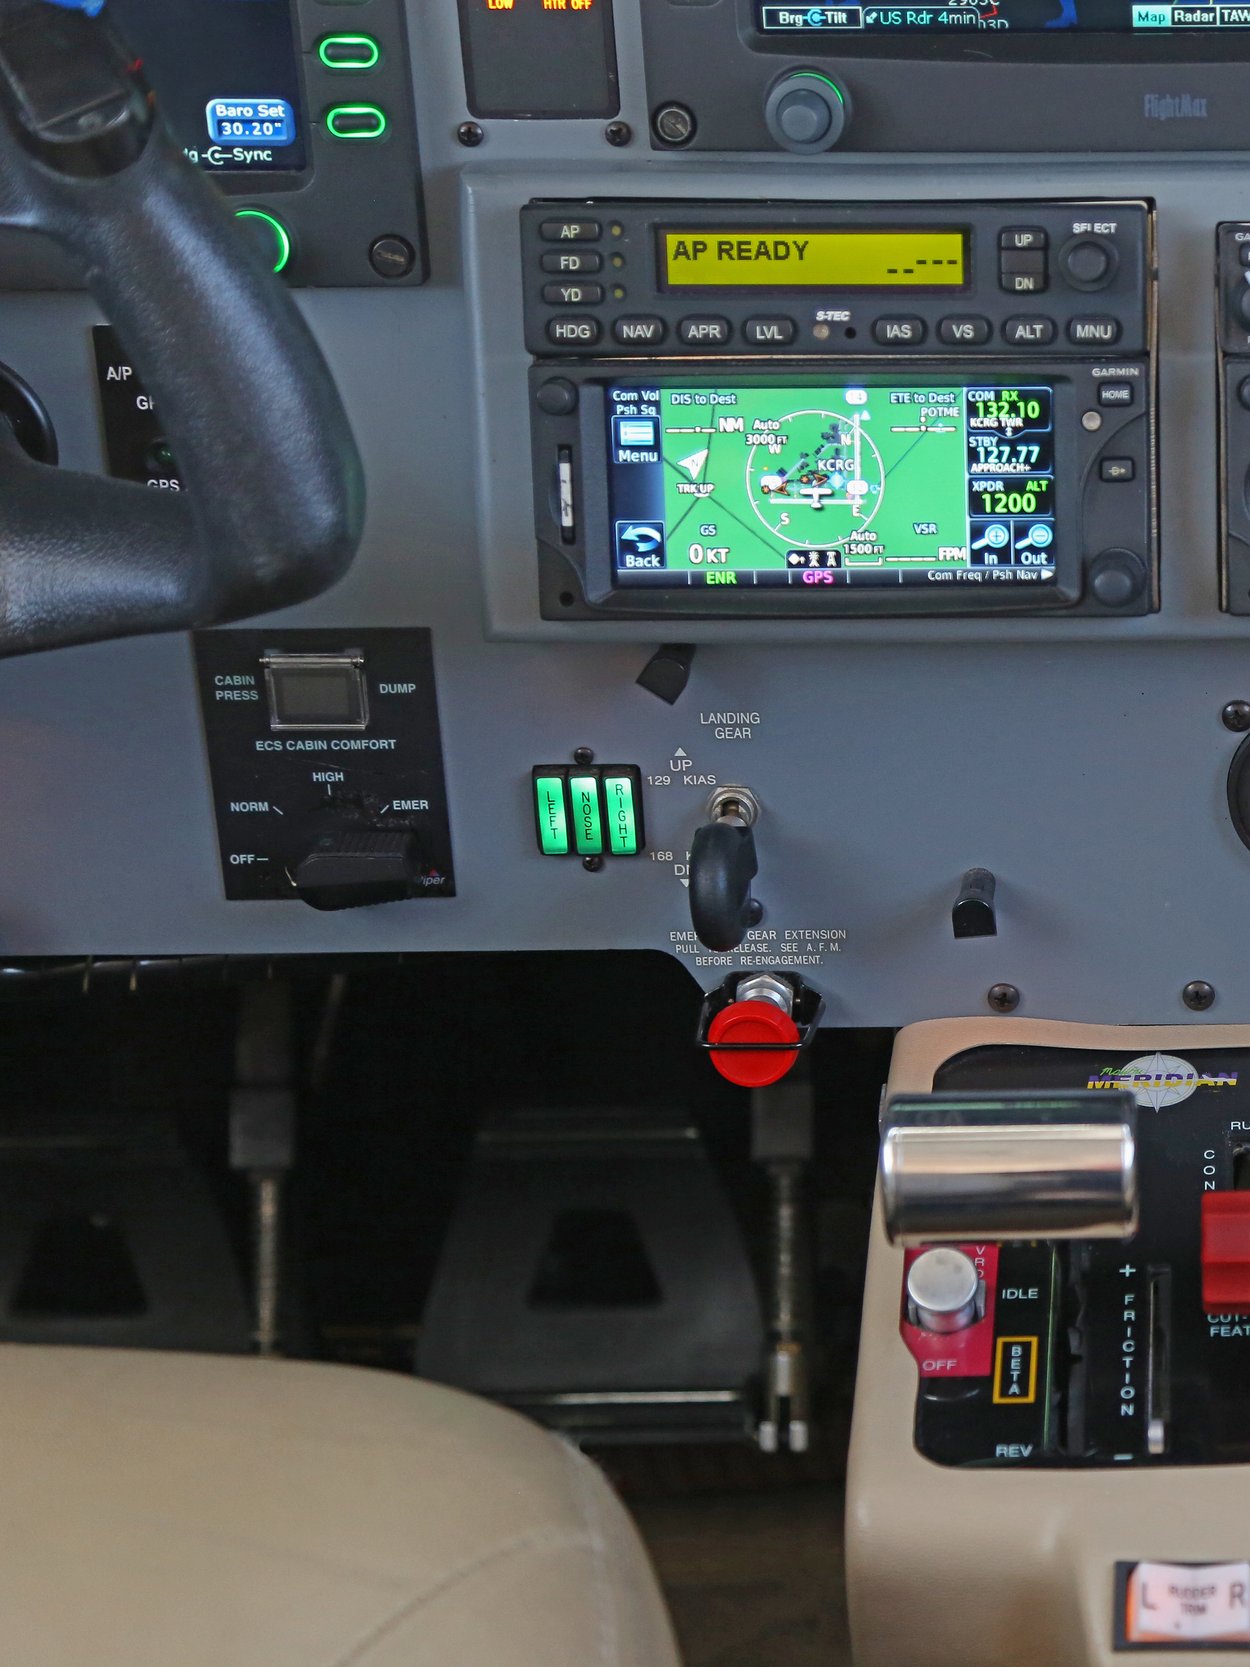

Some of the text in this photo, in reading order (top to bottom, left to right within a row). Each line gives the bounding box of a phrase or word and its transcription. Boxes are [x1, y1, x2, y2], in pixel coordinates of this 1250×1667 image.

[779, 11, 847, 26] Brg Tilt
[880, 11, 902, 25] US
[906, 10, 933, 25] Rdr
[938, 11, 976, 25] 4min
[1138, 12, 1165, 24] Map
[1174, 11, 1215, 23] Radar
[216, 104, 285, 117] Baro Set
[233, 147, 272, 163] Sync
[560, 226, 580, 239] AP
[1015, 234, 1033, 246] UP
[672, 240, 809, 261] AP READY
[560, 256, 580, 270] FD
[1015, 278, 1034, 290] DN
[561, 288, 581, 301] YD
[816, 310, 850, 321] S-TEC
[556, 324, 783, 339] HDG NAV APR LVL
[886, 325, 1112, 338] IAS VS ALT MNU
[107, 366, 132, 380] A/P
[1092, 368, 1139, 377] GARMIN
[613, 390, 659, 401] Com Vol
[671, 394, 737, 405] DIS to Dest
[968, 390, 1019, 401] COM RX
[976, 401, 1040, 419] 132.10
[618, 450, 658, 462] Menu
[976, 446, 1040, 463] 127.77
[972, 480, 1049, 491] XPDR ALT
[982, 493, 1037, 513] 1200
[625, 554, 661, 568] Back
[1021, 551, 1048, 565] Out
[706, 571, 737, 584] ENR
[802, 571, 834, 584] GPS
[215, 676, 255, 686] CABIN
[379, 684, 416, 694] DUMP
[216, 691, 259, 701] PRESS
[700, 712, 760, 724] LANDING
[714, 727, 752, 739] GEAR
[256, 740, 397, 751] ECS CABIN COMFORT
[669, 759, 693, 772] UP
[313, 772, 344, 782] HIGH
[647, 774, 716, 786] 129 KIAS
[231, 802, 268, 812] NORM
[393, 800, 429, 811] EMER
[546, 790, 558, 840] LEFT
[581, 791, 593, 840] NOSE
[615, 784, 628, 848] RIGHT
[230, 854, 255, 865] OFF
[650, 851, 673, 861] 168
[747, 929, 846, 940] GEAR EXTENSION
[696, 955, 824, 966] BEFORE RE-ENGAGEMENT.
[1087, 1072, 1238, 1089] MERIDIAN
[1002, 1288, 1039, 1299] IDLE
[1120, 1294, 1136, 1416] FRICTION
[922, 1360, 957, 1371] OFF
[1008, 1345, 1022, 1395] BETA
[995, 1444, 1034, 1458] REV
